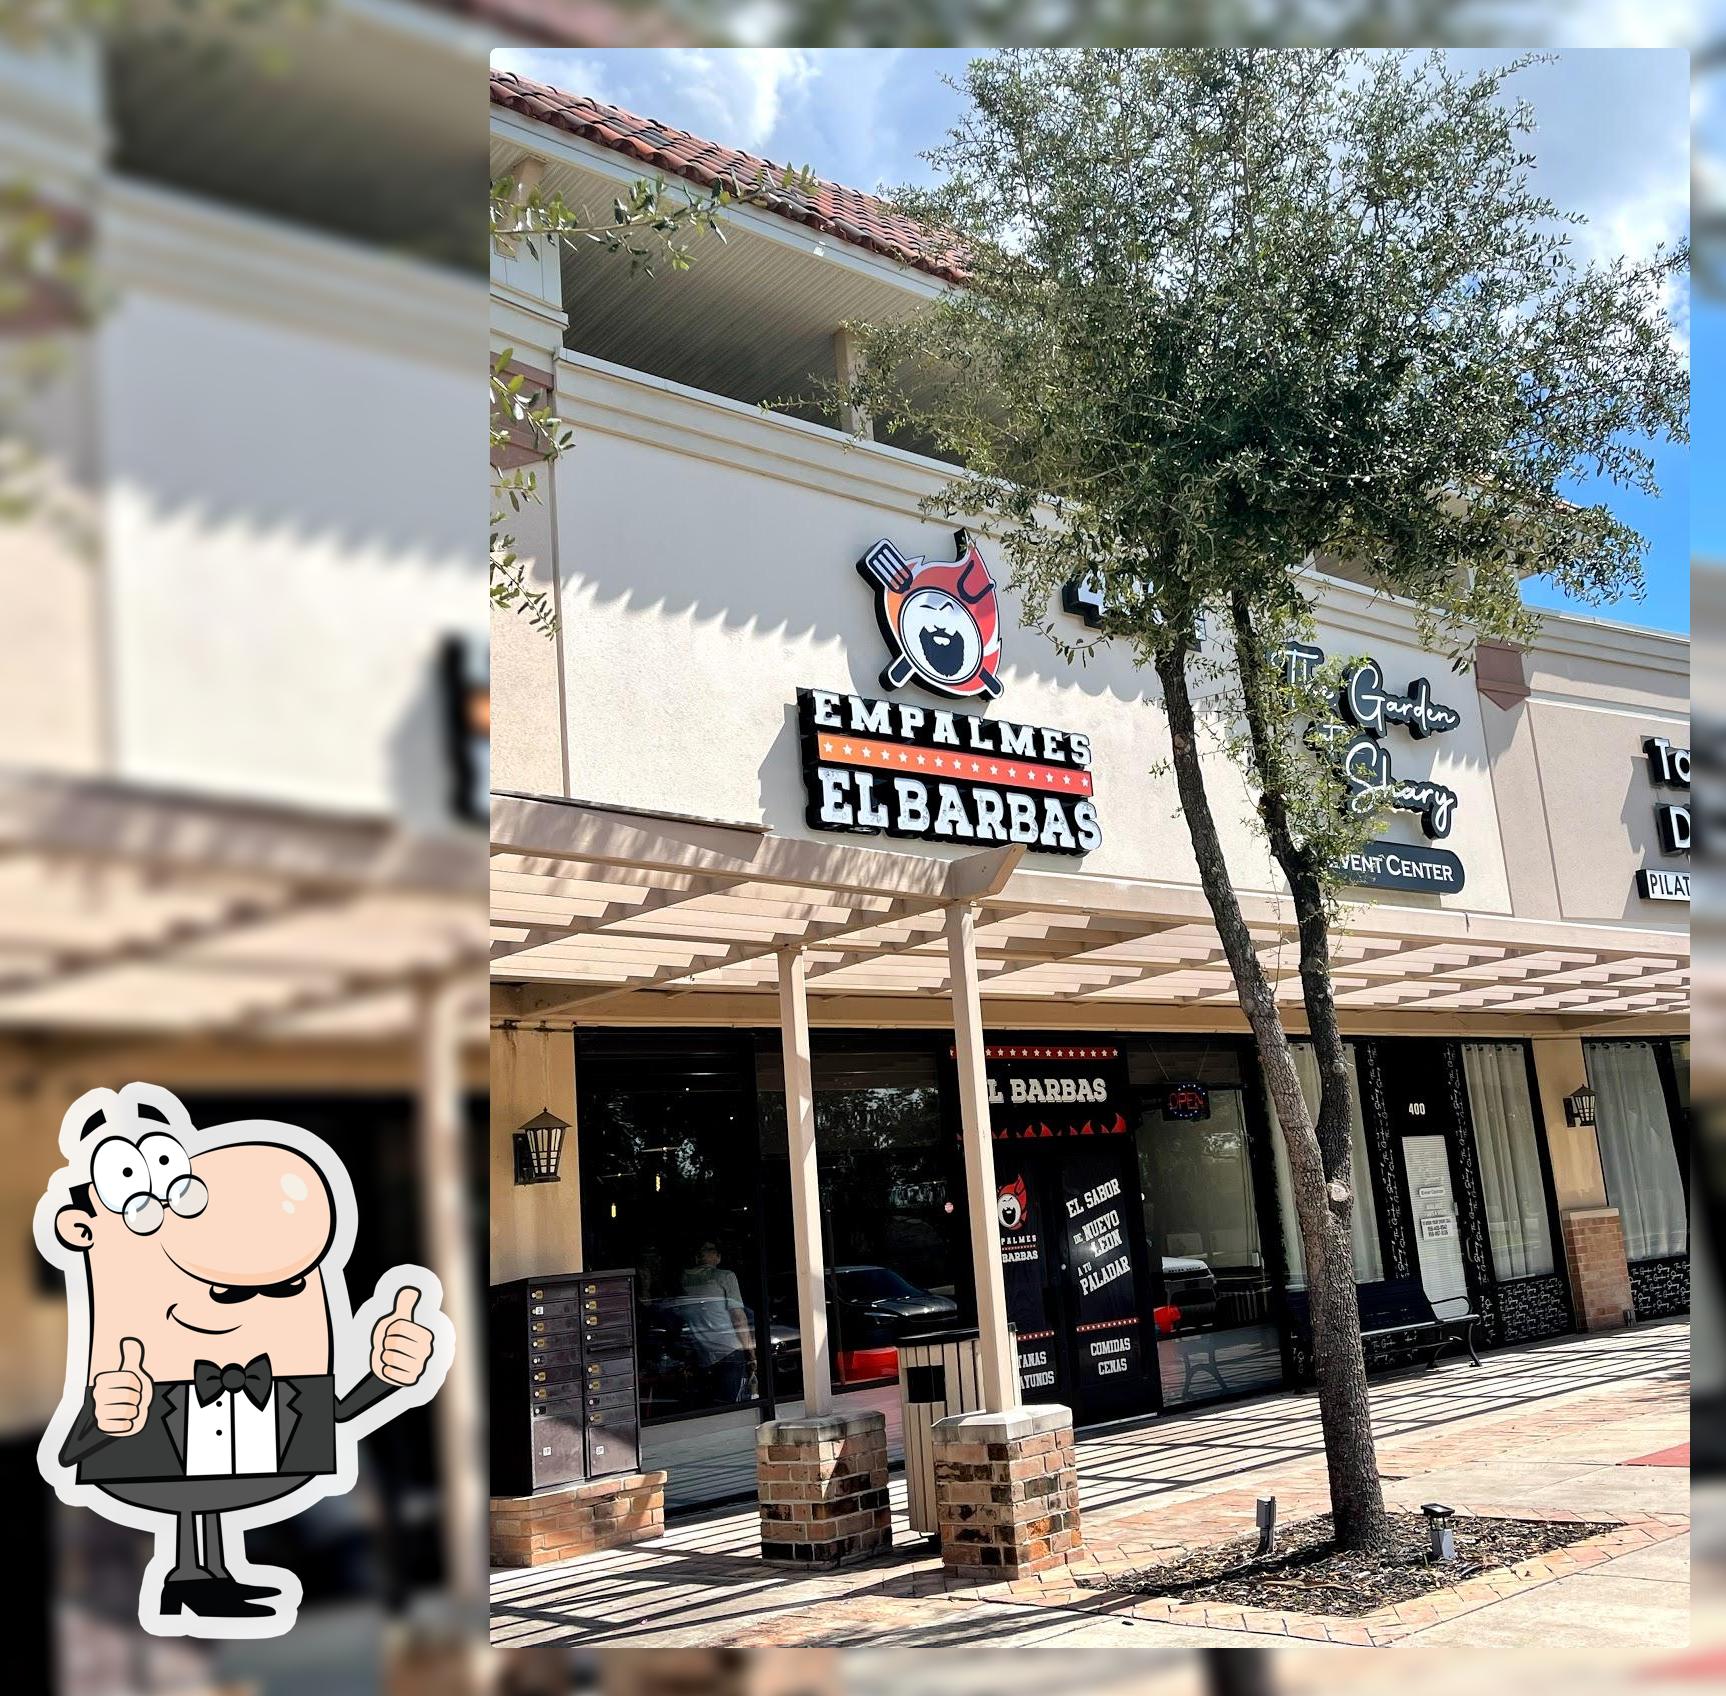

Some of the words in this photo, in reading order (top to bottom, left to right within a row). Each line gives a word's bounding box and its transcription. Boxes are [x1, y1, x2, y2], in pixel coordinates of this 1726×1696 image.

[1352, 664, 1455, 733] Garden
[812, 689, 1091, 765] EMPALMES
[1345, 741, 1455, 832] Shary
[818, 766, 889, 827] EL
[894, 778, 1102, 850] BARBAS
[1386, 854, 1454, 882] CENTER
[1650, 873, 1690, 896] PILAT
[1010, 1078, 1107, 1103] BARBAS
[1408, 1103, 1426, 1115] 400
[1066, 1198, 1085, 1218] EL
[1083, 1178, 1121, 1209] SABOR
[1072, 1233, 1084, 1245] DE
[1081, 1209, 1120, 1242] NUEVO
[1002, 1250, 1039, 1263] BARBAS
[1090, 1228, 1123, 1258] LEON
[1077, 1266, 1084, 1277] A
[1082, 1262, 1093, 1274] TU
[1080, 1256, 1131, 1296] PALADAR
[1090, 1337, 1131, 1357] COMIDAS
[1098, 1358, 1128, 1376] CENAS
